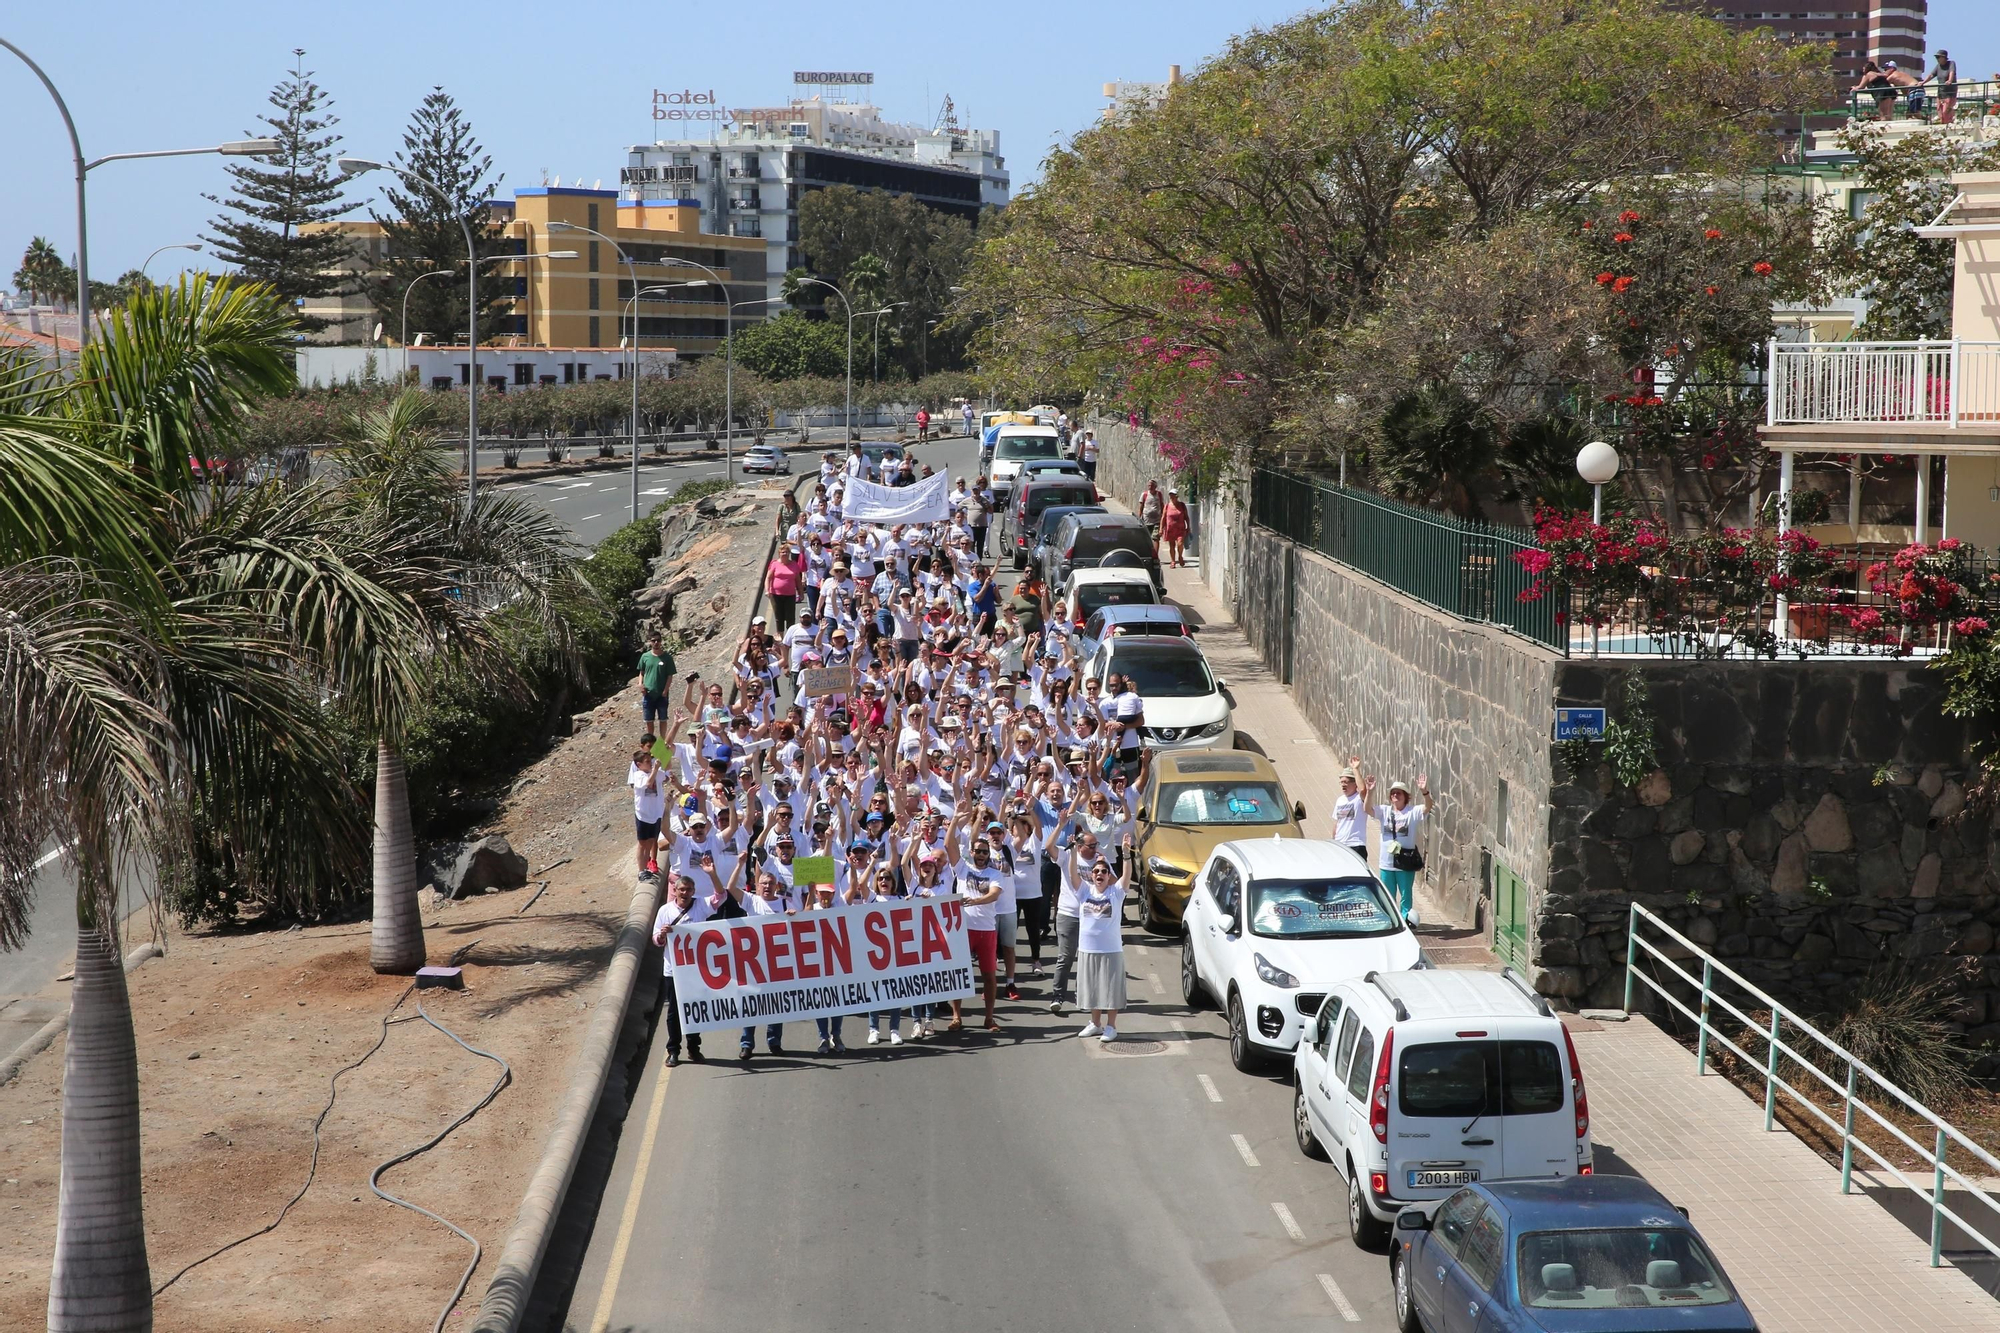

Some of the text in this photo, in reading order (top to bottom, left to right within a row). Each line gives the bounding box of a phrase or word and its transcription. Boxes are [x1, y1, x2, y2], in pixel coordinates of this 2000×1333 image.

[795, 72, 873, 83] EUROPALACE
[652, 89, 716, 104] hotel
[652, 105, 805, 125] beverly park
[1561, 727, 1570, 735] LA
[1273, 906, 1296, 916] KIA
[683, 967, 971, 1025] POR UNA ADMINISTRACION LEAL Y TRANSPARENTE
[1417, 1172, 1478, 1185] 2003 HBM
